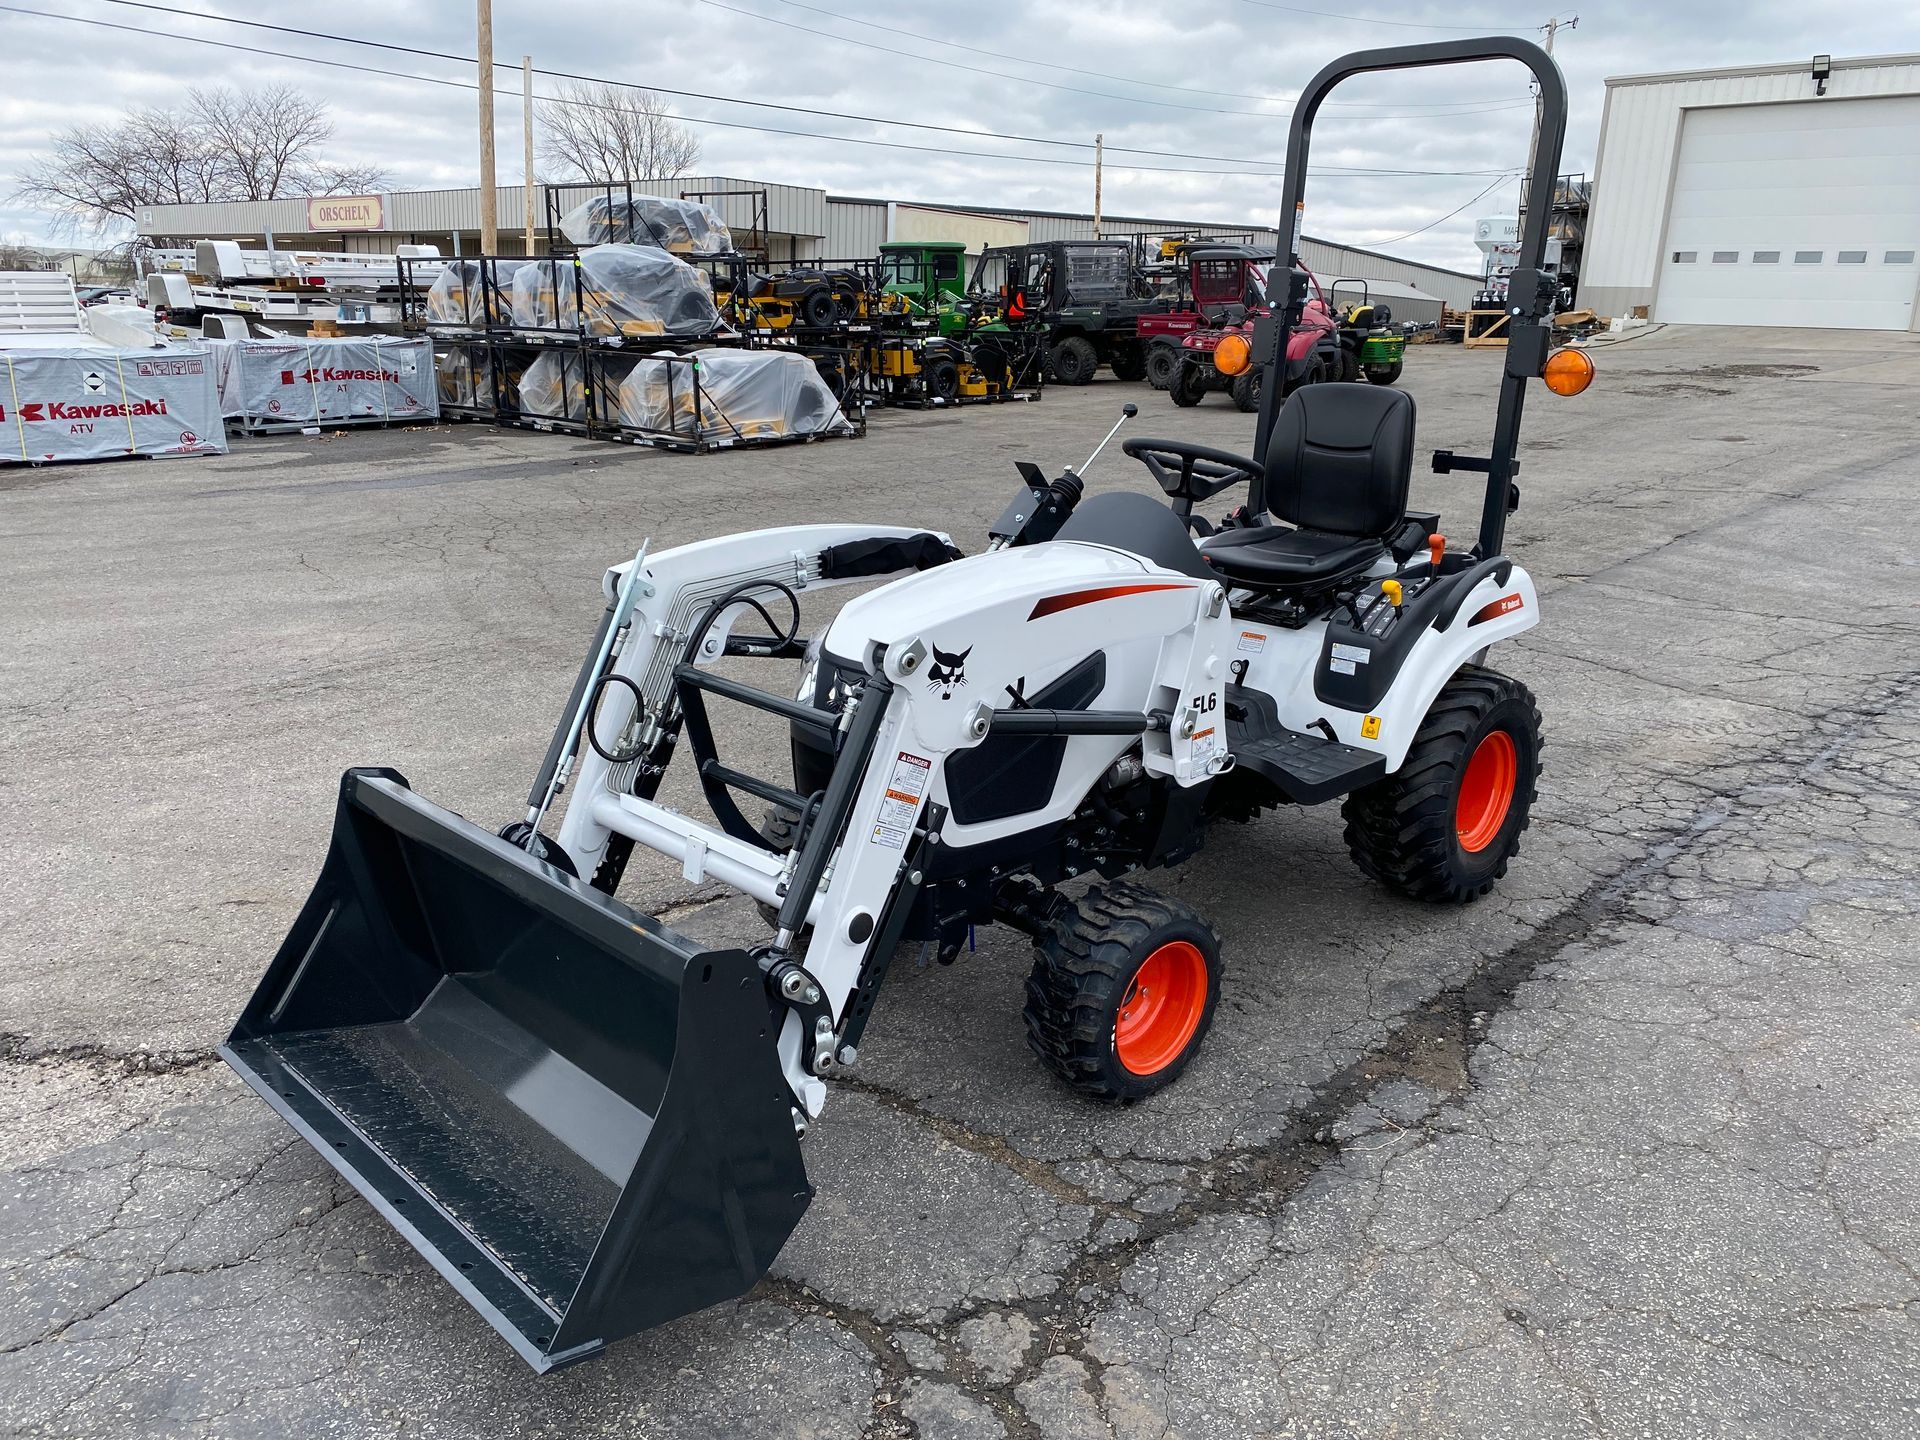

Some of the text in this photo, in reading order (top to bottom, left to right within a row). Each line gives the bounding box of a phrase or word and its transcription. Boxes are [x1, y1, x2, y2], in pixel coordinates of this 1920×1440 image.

[319, 206, 370, 221] ORSCHELN
[48, 399, 167, 420] Kawasaki
[70, 423, 94, 434] ATV
[906, 756, 929, 767] DANGER
